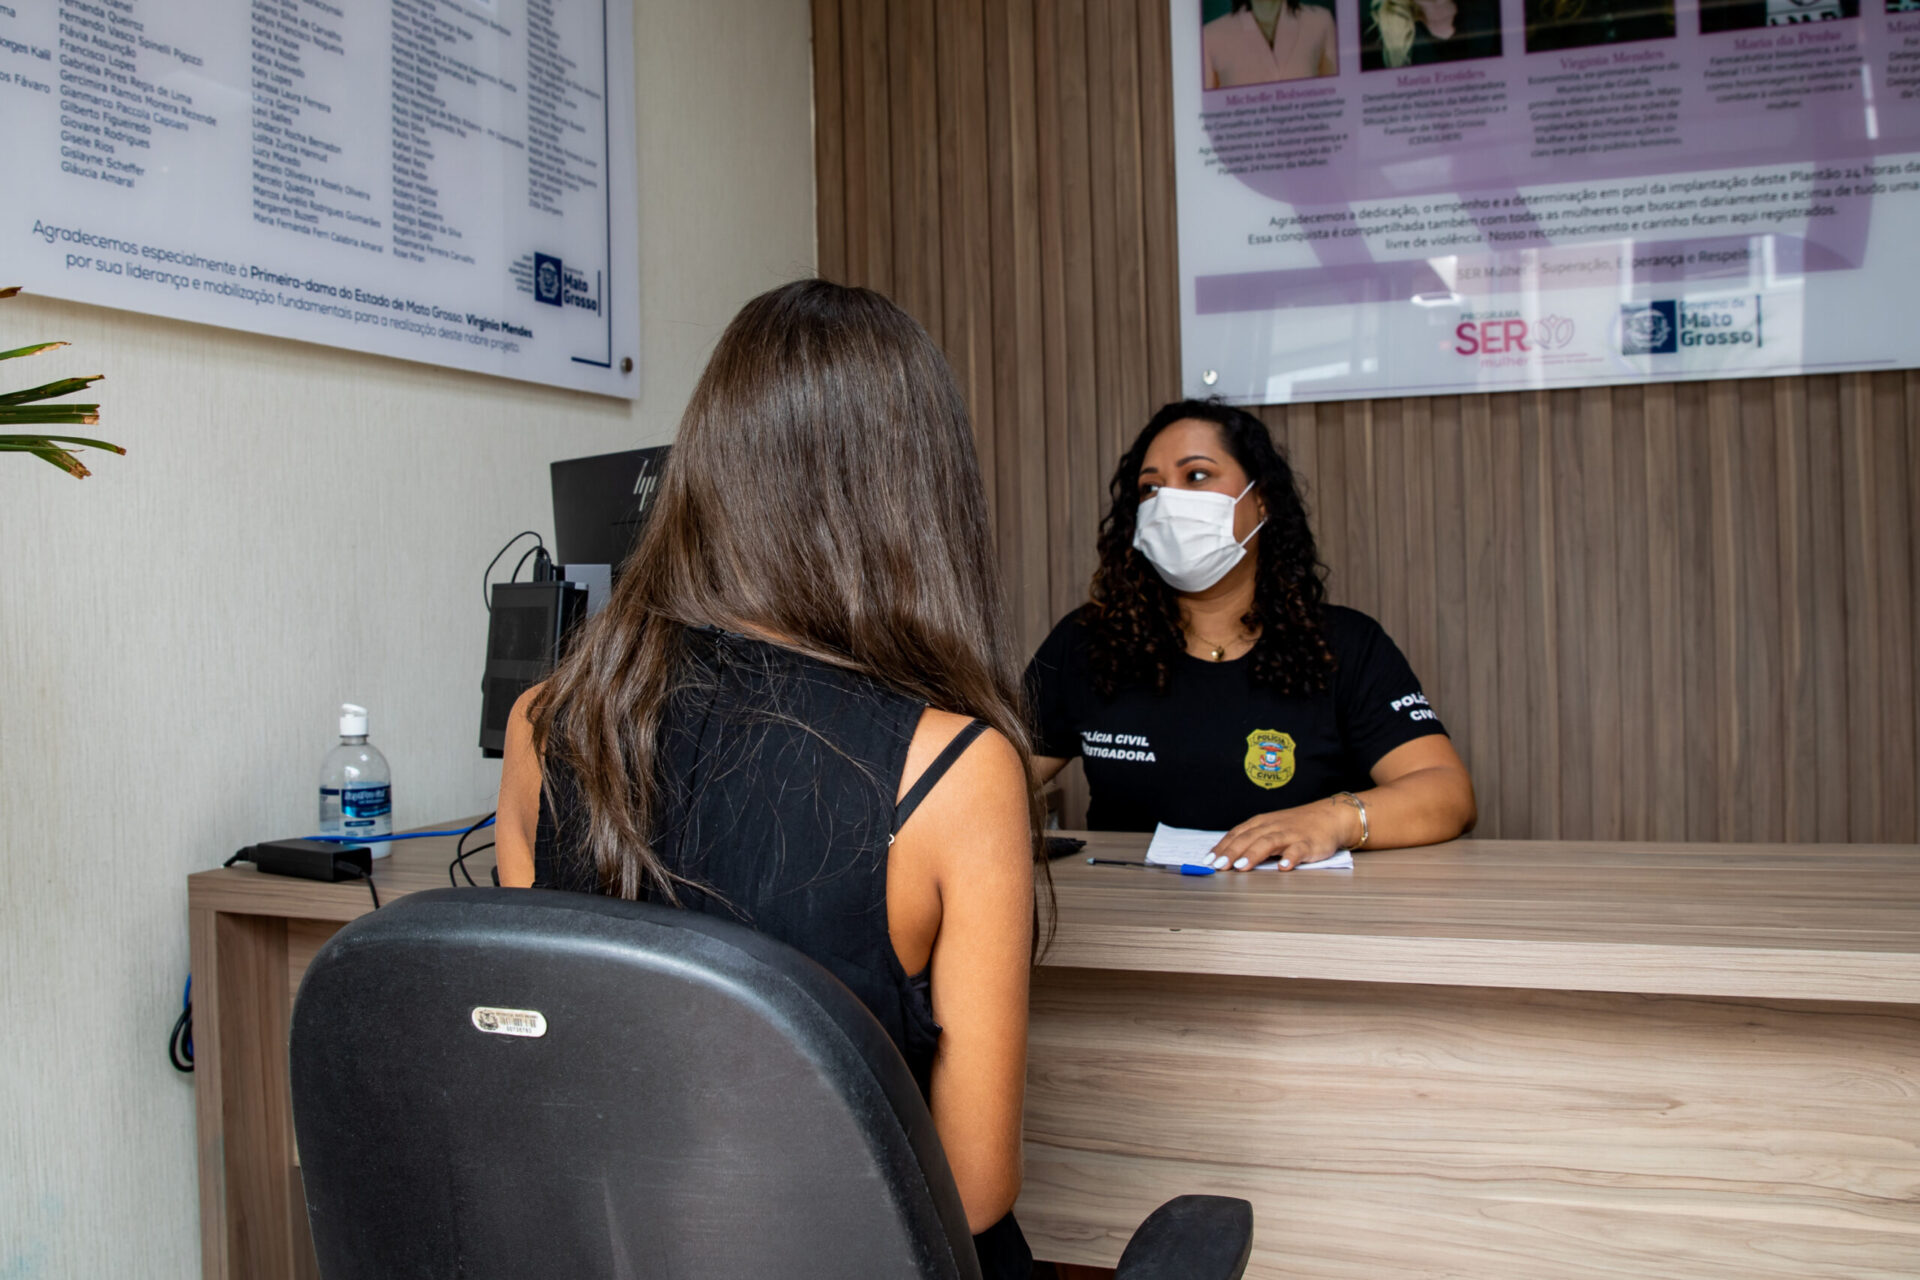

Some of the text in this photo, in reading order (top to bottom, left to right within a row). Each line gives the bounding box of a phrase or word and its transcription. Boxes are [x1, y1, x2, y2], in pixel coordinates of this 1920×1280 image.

[0, 40, 28, 54] orges
[1269, 212, 1346, 228] Agradecemos
[1358, 203, 1419, 219] dedicação,
[1422, 205, 1431, 213] o
[1433, 197, 1489, 214] empenho
[1492, 199, 1500, 207] e
[1512, 188, 1597, 206] determinação
[1599, 189, 1619, 198] em
[1622, 183, 1648, 199] prol
[1669, 176, 1748, 194] implantação
[1750, 174, 1786, 186] deste
[1789, 168, 1841, 182] Plantão
[1845, 165, 1860, 178] 24
[1863, 165, 1901, 176] horas
[1248, 233, 1272, 245] Essa
[1275, 229, 1329, 244] conquista
[1331, 226, 1339, 238] é
[1341, 220, 1424, 238] compartilhada
[1427, 216, 1477, 230] também
[1479, 216, 1506, 226] com
[1509, 211, 1542, 223] todas
[1545, 212, 1558, 220] as
[1560, 206, 1618, 219] mulheres
[1621, 205, 1645, 217] que
[1647, 200, 1696, 212] buscam
[1699, 193, 1777, 208] diariamente
[1780, 193, 1789, 201] e
[1792, 188, 1831, 200] acima
[1834, 185, 1851, 197] de
[1853, 182, 1886, 195] tudo
[1385, 237, 1409, 249] livre
[1412, 235, 1428, 247] de
[1487, 229, 1527, 241] Nosso
[1529, 221, 1629, 237] reconhecimento
[1631, 221, 1639, 229] e
[1641, 214, 1689, 228] carinho
[1692, 213, 1728, 224] ficam
[1731, 208, 1757, 224] aqui
[33, 220, 138, 255] Agradecemos
[142, 247, 236, 275] especialmente
[250, 265, 337, 296] Primeira-dama
[339, 283, 352, 299] do
[355, 287, 389, 307] Estado
[391, 294, 404, 310] de
[406, 297, 430, 316] Mato
[563, 273, 589, 293] Mato
[66, 254, 90, 269] por
[96, 260, 121, 274] sua
[126, 263, 188, 290] liderança
[192, 279, 200, 290] e
[203, 281, 273, 305] mobilização
[277, 291, 351, 319] fundamentais
[354, 310, 378, 324] para
[389, 316, 437, 338] realização
[438, 323, 462, 341] deste
[464, 331, 488, 346] nobre
[563, 289, 598, 312] Grosso
[1680, 312, 1733, 329] Mato
[1455, 318, 1532, 356] SER
[1680, 330, 1753, 347] Grosso
[633, 459, 657, 512] hp
[1114, 733, 1150, 747] CIVIL
[1257, 734, 1285, 744] POLÍCIA
[1257, 772, 1281, 780] CIVIL
